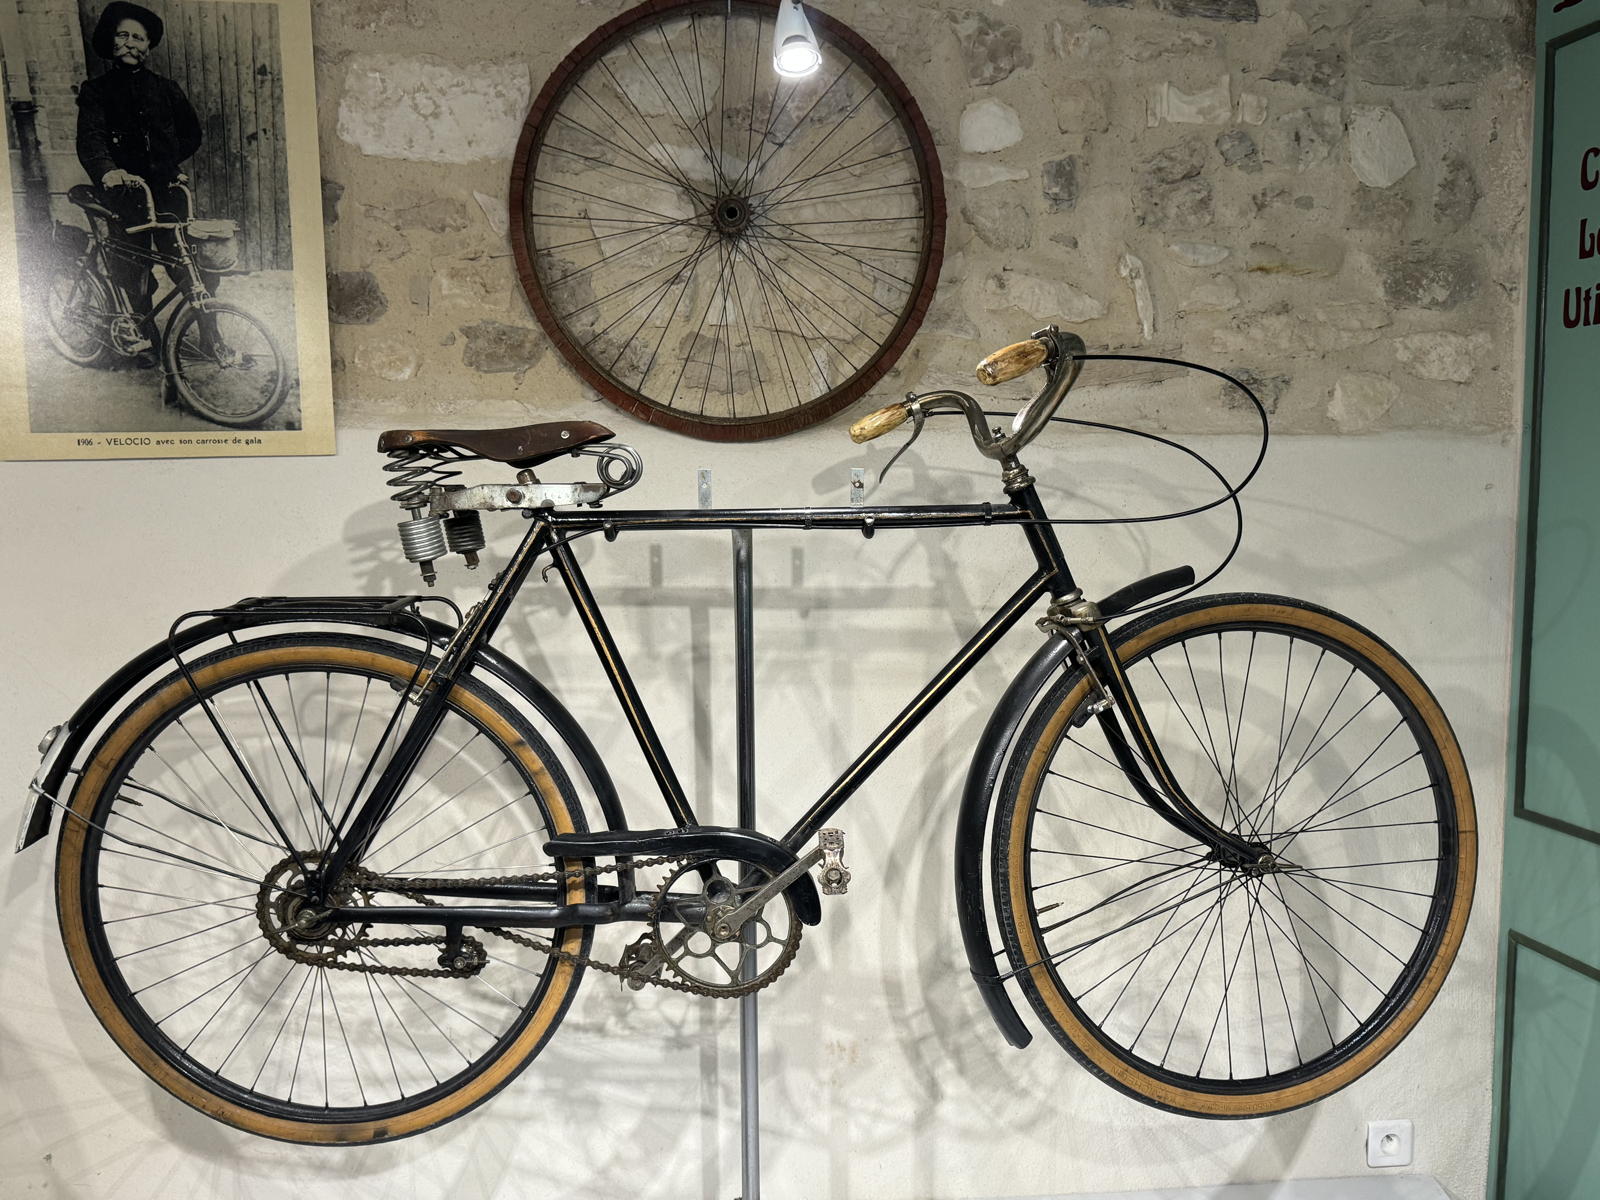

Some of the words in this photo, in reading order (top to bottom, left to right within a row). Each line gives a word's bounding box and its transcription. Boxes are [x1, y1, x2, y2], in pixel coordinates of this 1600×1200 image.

[77, 438, 93, 446] 1906
[105, 437, 151, 446] VELOCIO
[232, 436, 243, 444] de
[245, 437, 262, 446] gala
